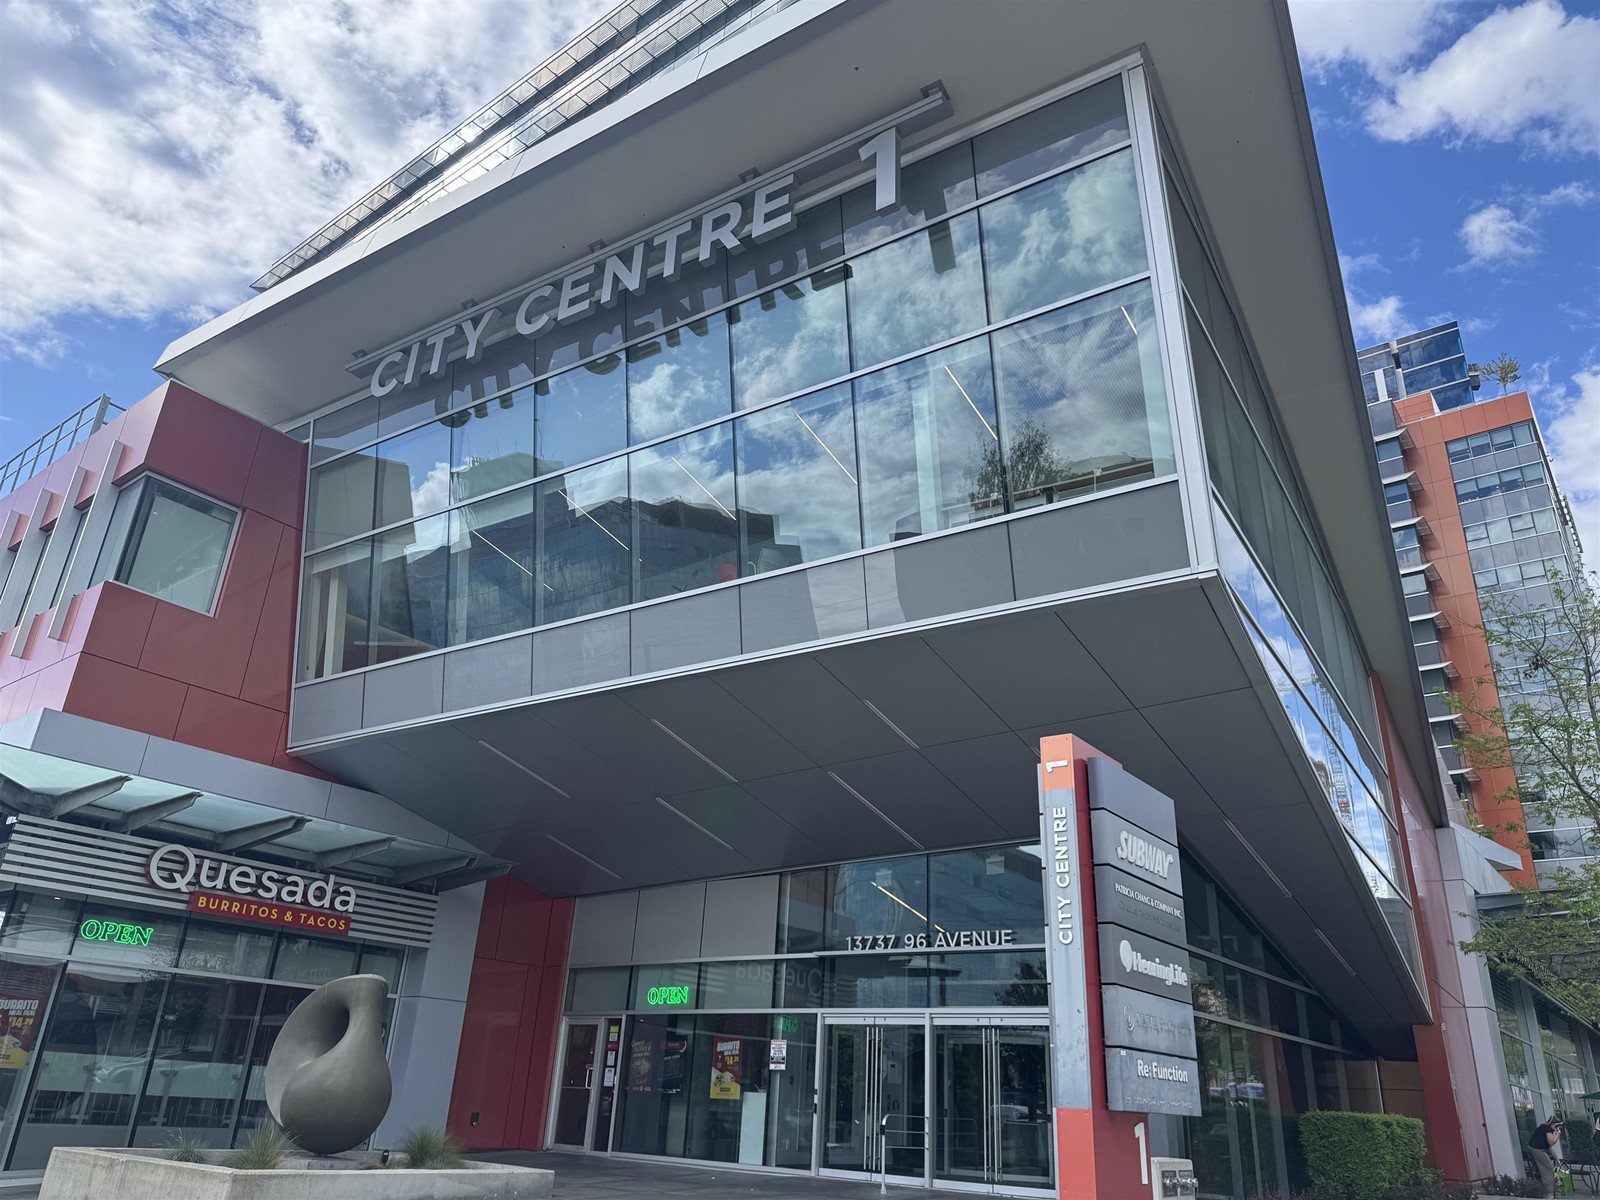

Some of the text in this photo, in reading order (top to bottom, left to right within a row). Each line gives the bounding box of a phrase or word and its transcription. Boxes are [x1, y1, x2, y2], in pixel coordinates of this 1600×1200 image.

[370, 127, 900, 397] CITY CENTRE 1
[1045, 759, 1068, 773] 1
[1116, 830, 1174, 880] SUBWAY
[146, 843, 357, 913] Quesada
[1053, 806, 1073, 945] CITY CENTRE
[197, 896, 347, 931] BURRITOS & TACOS
[1115, 883, 1135, 899] PATRICIA
[1134, 891, 1151, 906] CHANG
[1154, 900, 1174, 916] COMPANY
[80, 919, 154, 946] OPEN
[846, 929, 1013, 951] 13737 96 AVENUE
[1132, 950, 1188, 987] HearingLife
[647, 986, 689, 1005] OPEN
[1137, 1059, 1188, 1083] Re:Function
[1134, 1121, 1149, 1185] 1
